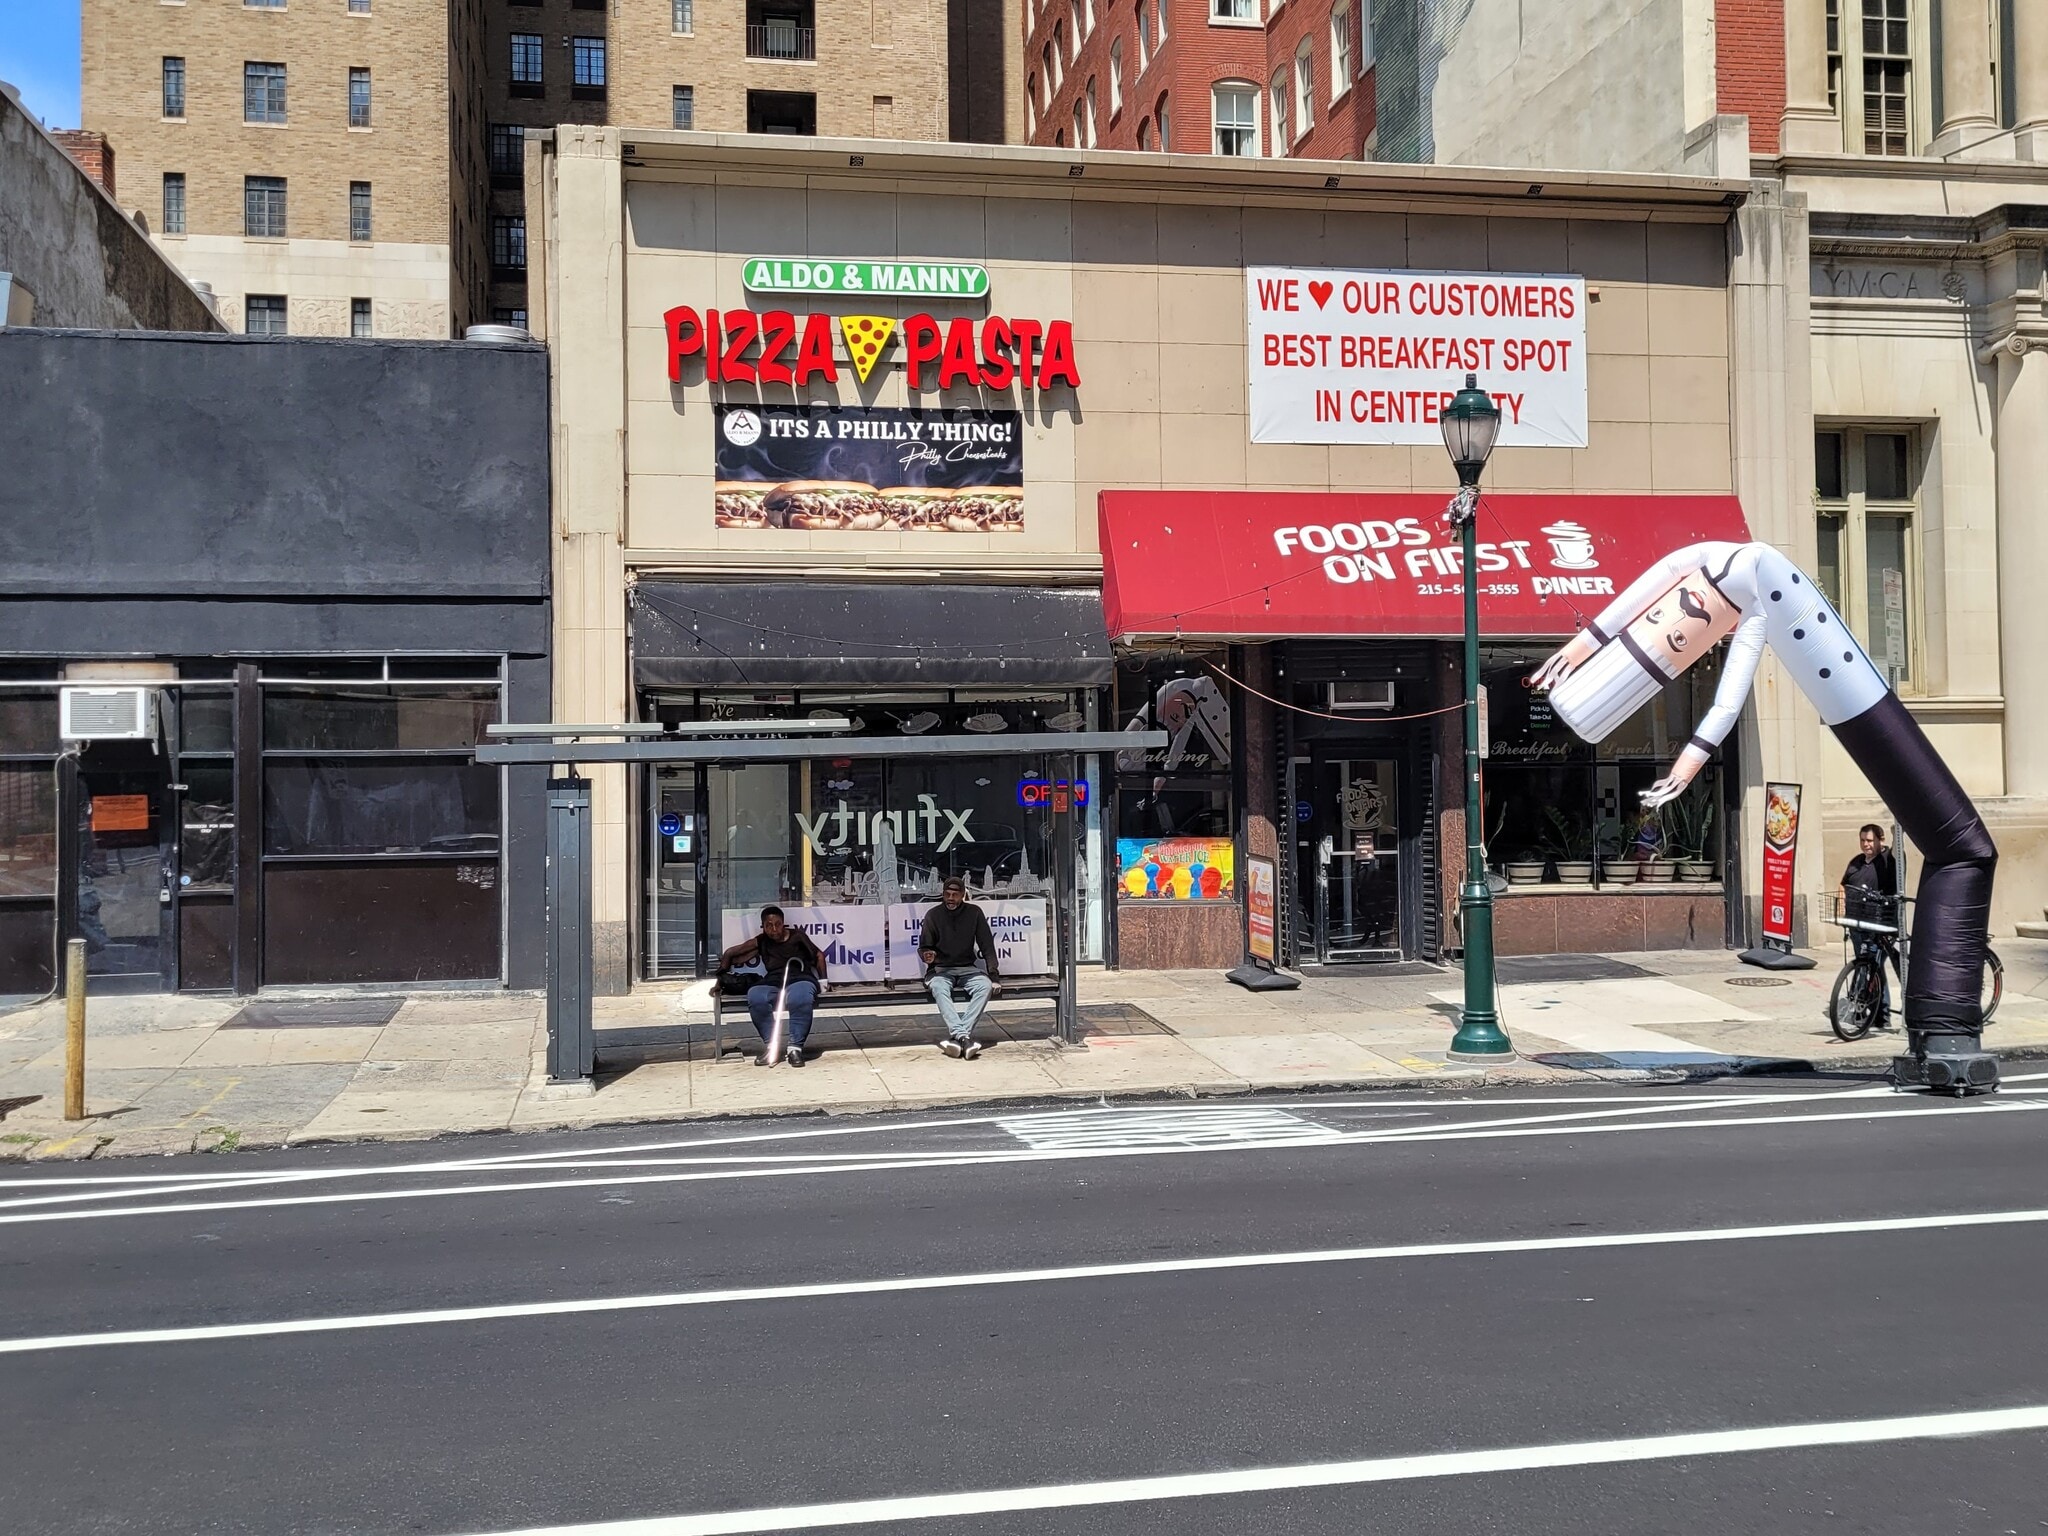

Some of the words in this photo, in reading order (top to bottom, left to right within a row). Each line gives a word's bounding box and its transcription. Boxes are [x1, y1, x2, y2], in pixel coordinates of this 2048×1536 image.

[752, 263, 837, 289] ALDO
[842, 264, 864, 291] &
[871, 266, 982, 293] MANNY
[1257, 279, 1300, 312] WE
[1342, 281, 1401, 314] OUR
[1409, 282, 1575, 319] CUSTOMERS
[663, 305, 839, 387] PIZZA
[902, 313, 1081, 390] PASTA
[1263, 334, 1332, 368] BEST
[1340, 336, 1496, 371] BREAKFAST
[1503, 339, 1573, 372] SPOT
[1316, 390, 1341, 422] IN
[769, 419, 809, 438] ITS
[814, 420, 833, 438] A
[838, 421, 923, 440] PHILLY
[928, 422, 1012, 442] THING!
[896, 441, 942, 471] Philly
[945, 441, 1008, 462] Cheesesteaks
[1273, 518, 1430, 556] FOODS
[1323, 551, 1397, 584] ON
[1404, 541, 1531, 578] FIRST
[1417, 584, 1519, 595] 215-5-3555
[1532, 576, 1615, 595] DINER
[1127, 748, 1209, 768] Cateing
[1491, 741, 1569, 760] Breakfast
[1602, 741, 1651, 755] Lunch
[1022, 785, 1084, 801] OPN
[832, 922, 844, 934] IS
[904, 918, 924, 930] LIK
[1001, 931, 1026, 942] ALL
